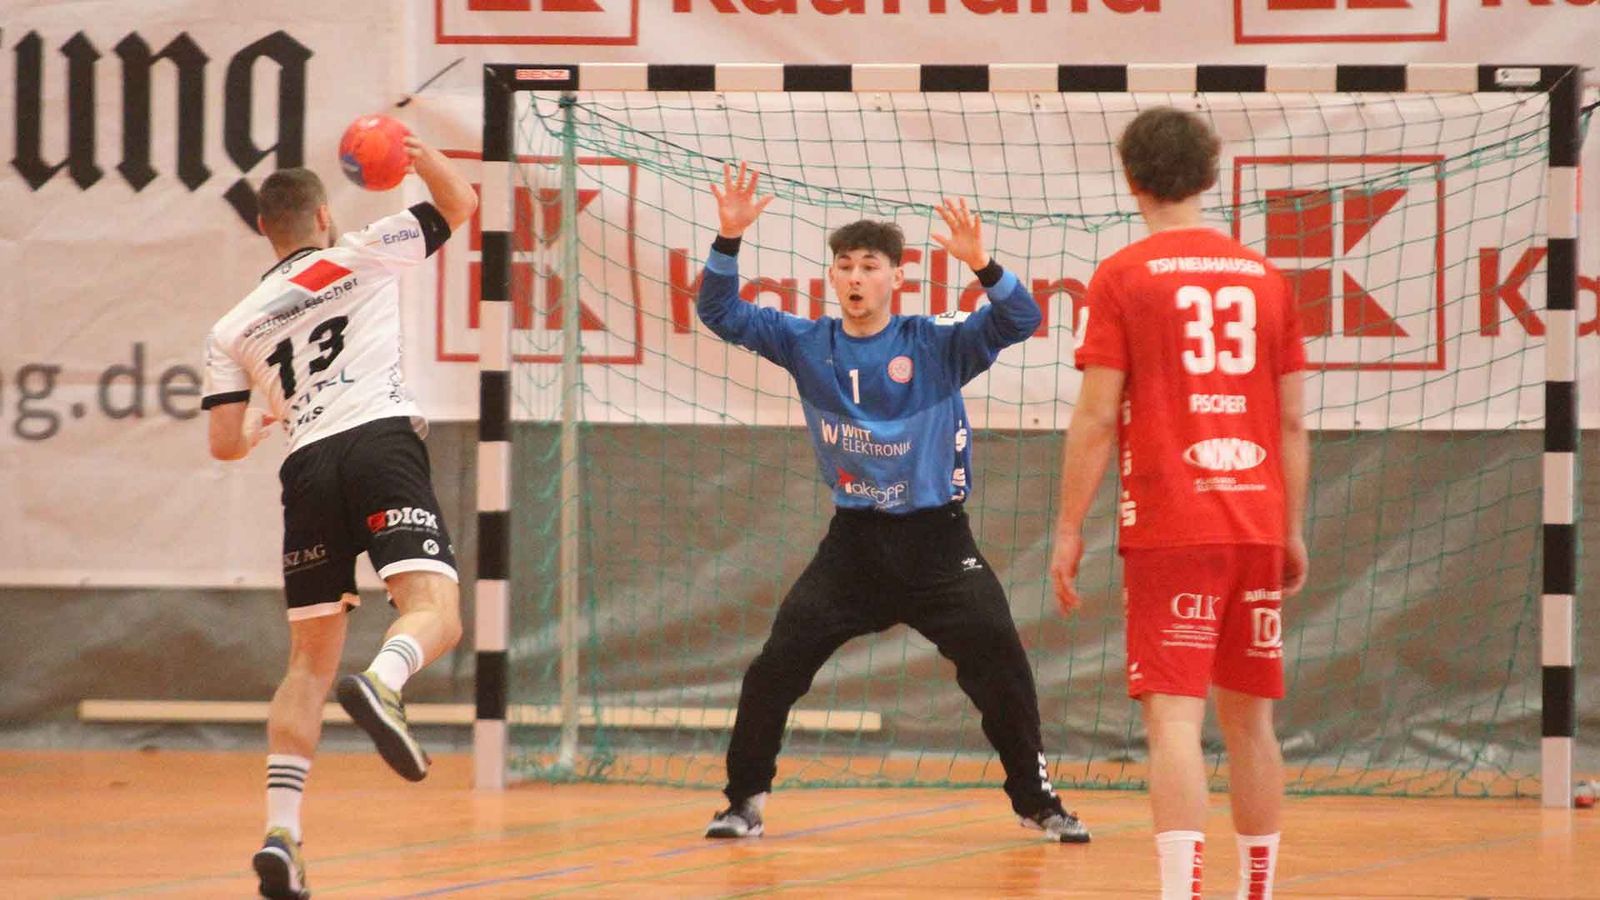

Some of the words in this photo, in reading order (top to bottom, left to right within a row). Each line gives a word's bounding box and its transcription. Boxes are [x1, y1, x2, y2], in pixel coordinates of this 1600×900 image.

[0, 28, 314, 236] ung
[266, 315, 350, 401] 13
[1176, 285, 1257, 376] 33
[0, 342, 204, 441] g.de
[849, 368, 861, 405] 1
[841, 423, 872, 442] WITT
[842, 437, 912, 457] ELEKTRONIK
[385, 506, 439, 530] DICK
